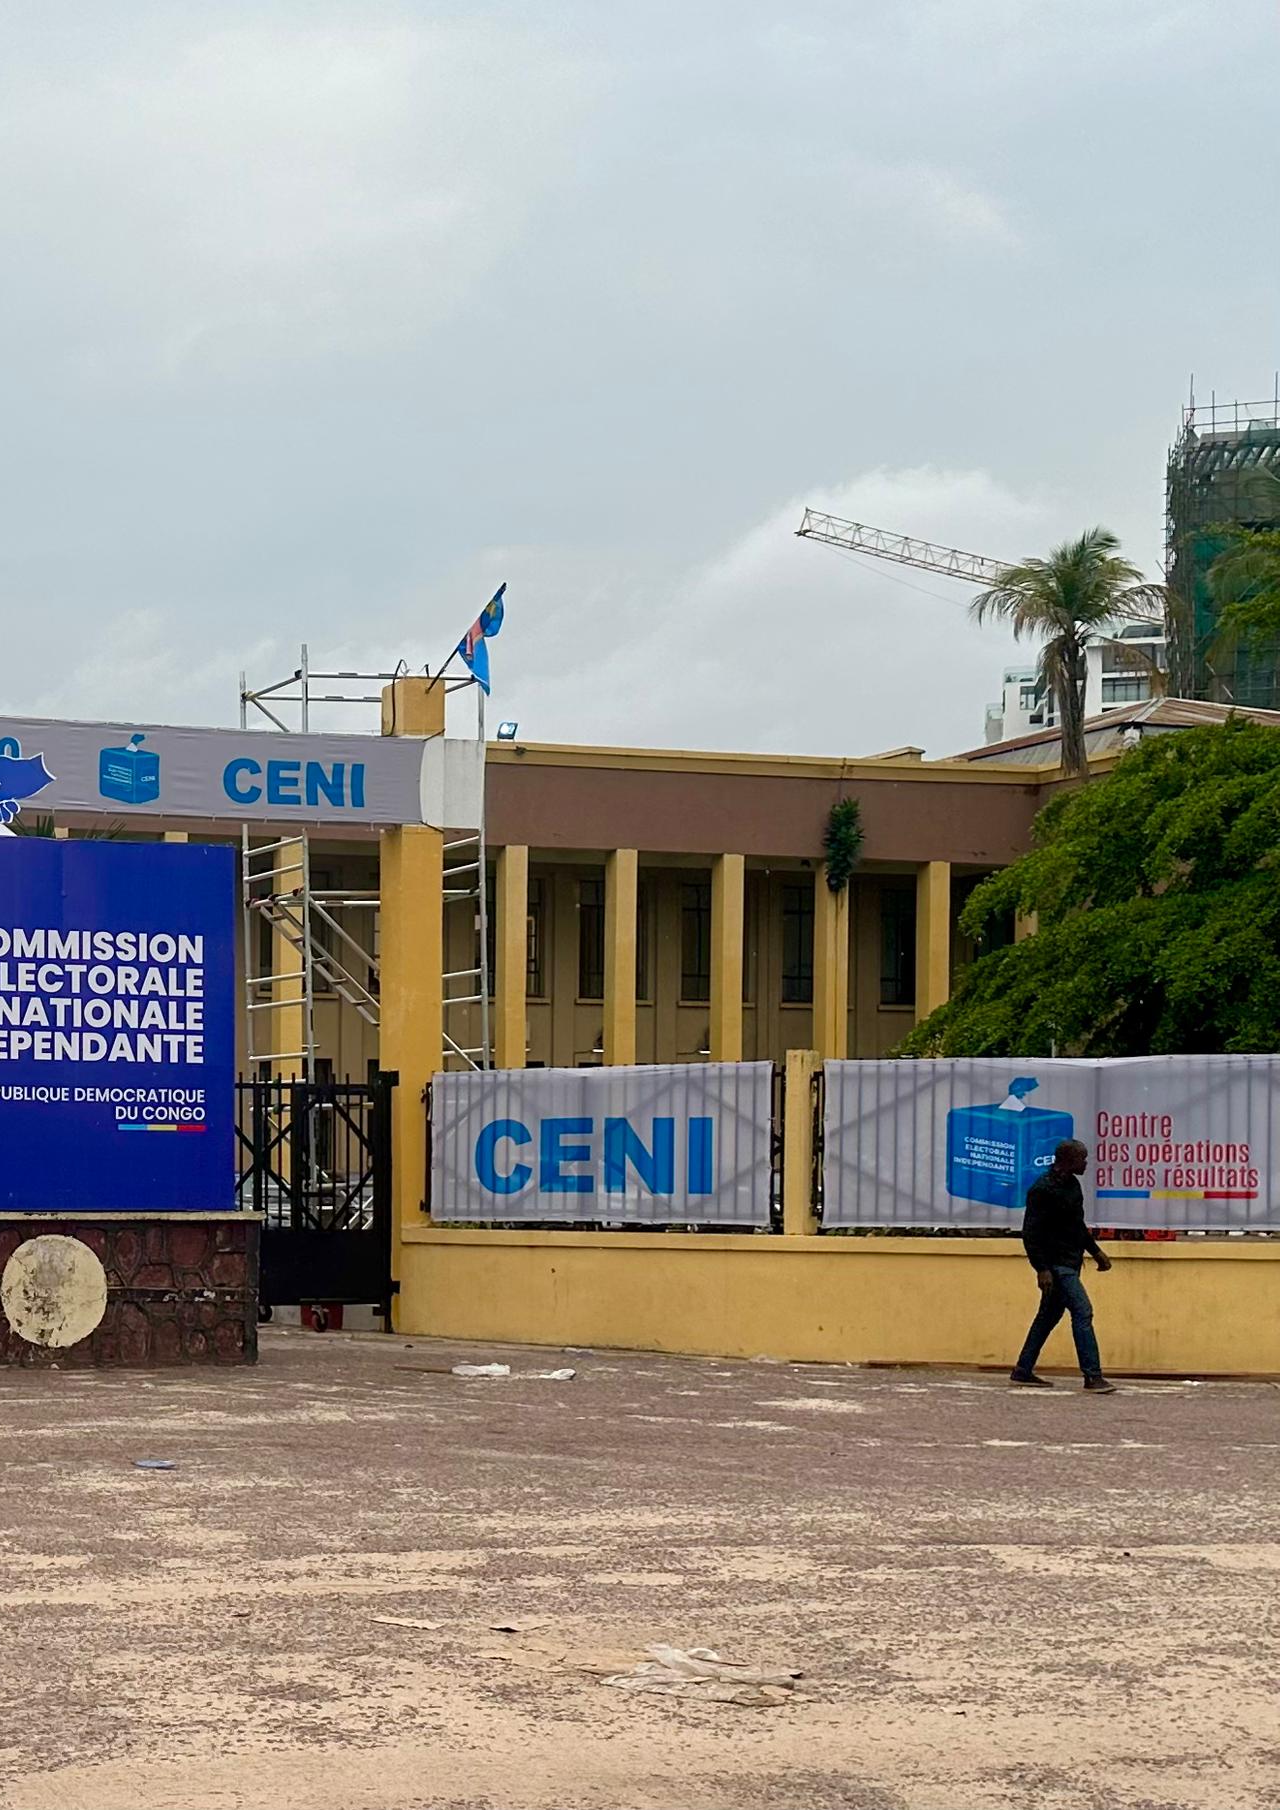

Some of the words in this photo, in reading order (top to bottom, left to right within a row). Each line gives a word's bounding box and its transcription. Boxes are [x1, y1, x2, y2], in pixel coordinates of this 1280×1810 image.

[223, 757, 365, 808] CENI
[74, 1088, 205, 1104] DEMOCRATIQUE
[115, 1106, 138, 1120] DU
[142, 1106, 206, 1121] CONGO
[1097, 1111, 1172, 1138] Centre
[475, 1117, 713, 1195] CENI
[1096, 1140, 1130, 1163] des
[1136, 1139, 1250, 1166] opérations
[1096, 1165, 1114, 1188] et
[1122, 1165, 1156, 1188] des
[1164, 1164, 1259, 1188] résultats
